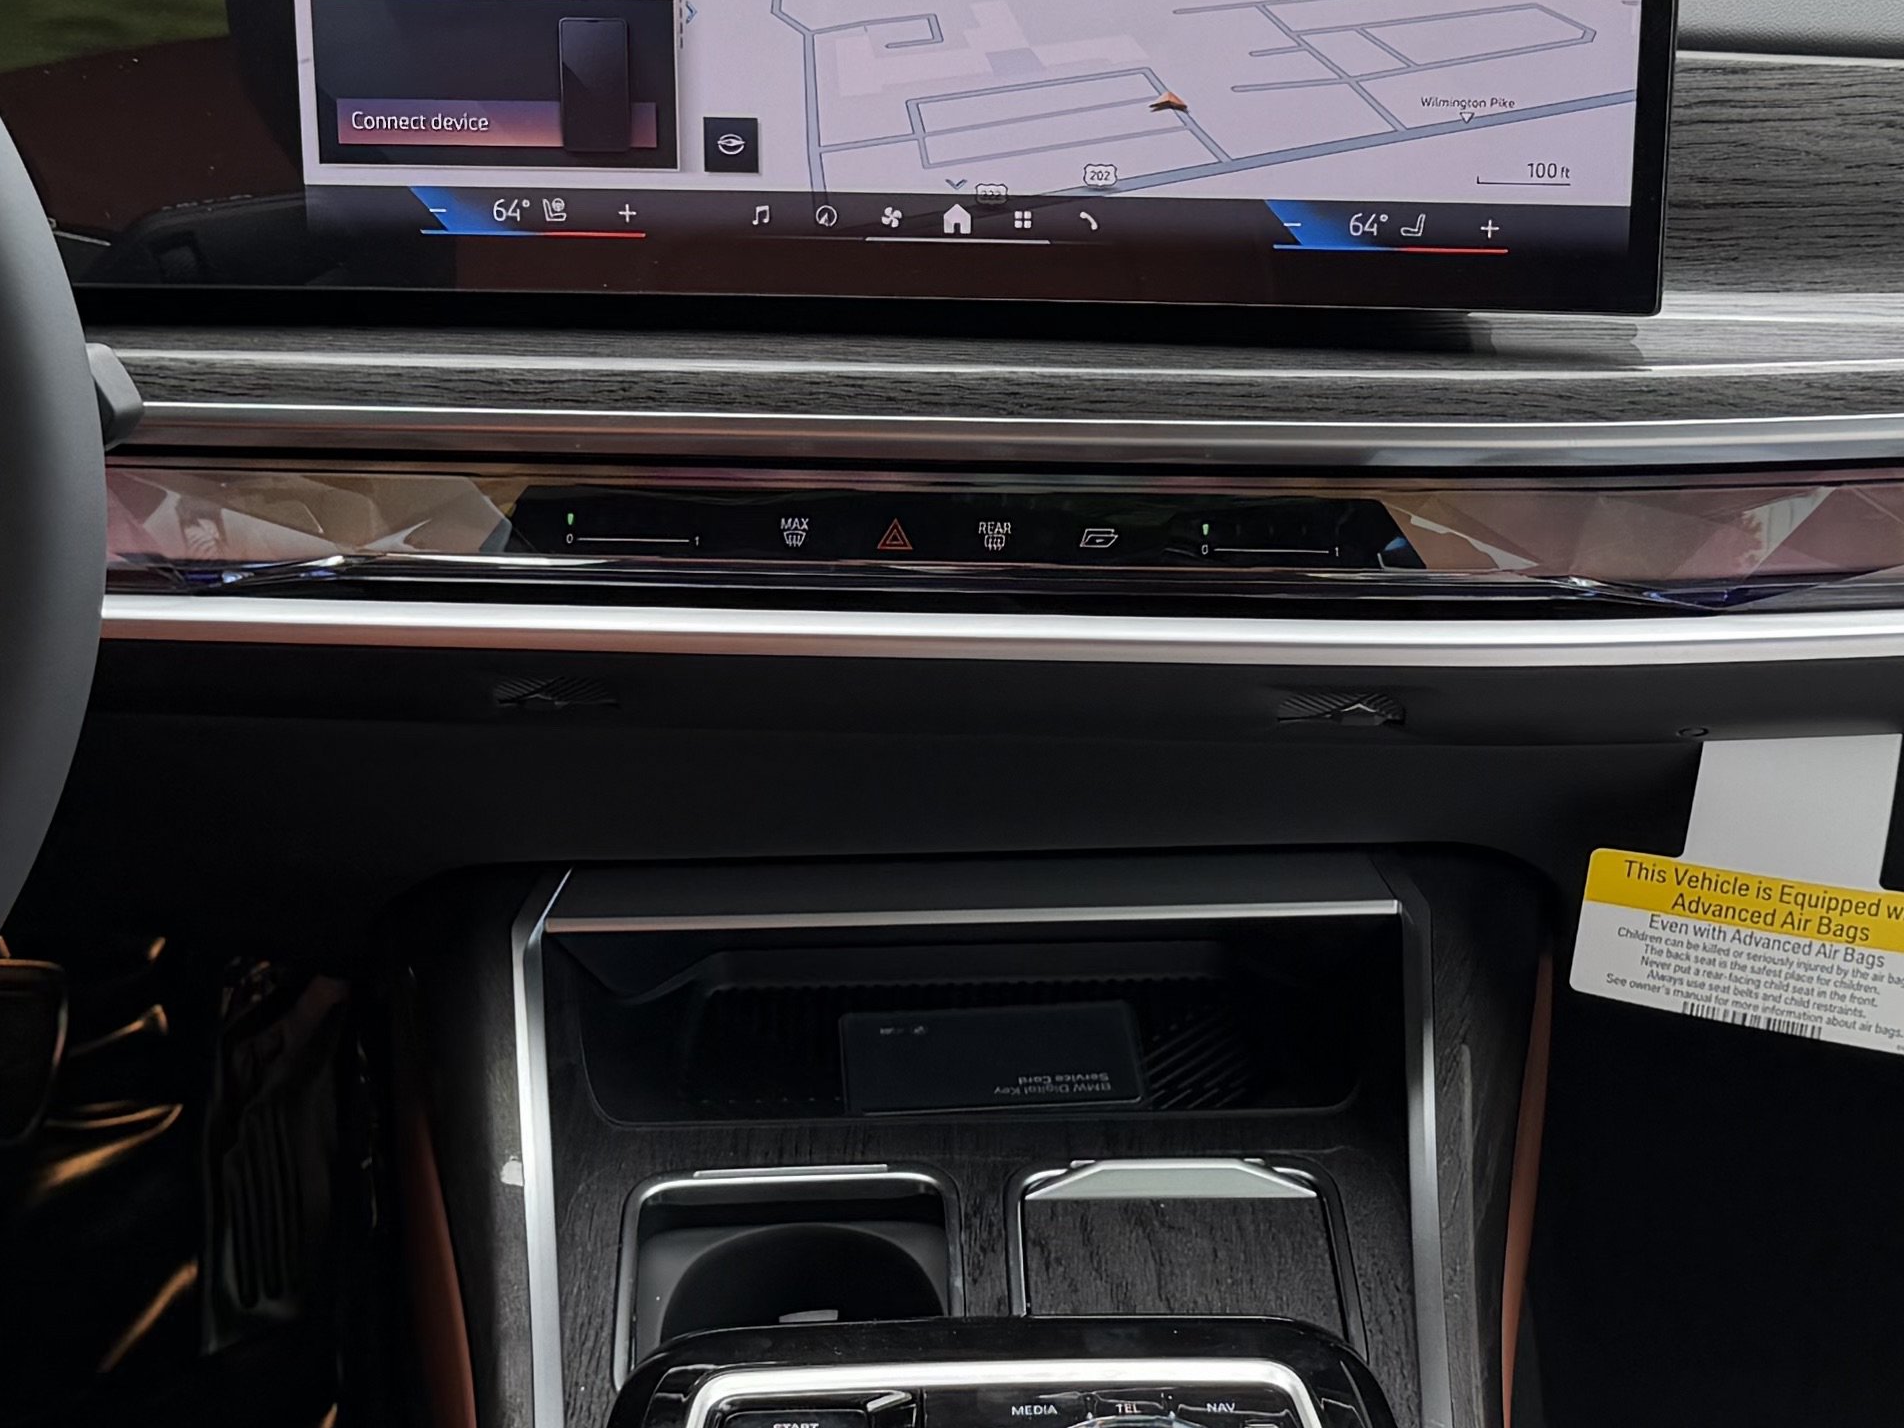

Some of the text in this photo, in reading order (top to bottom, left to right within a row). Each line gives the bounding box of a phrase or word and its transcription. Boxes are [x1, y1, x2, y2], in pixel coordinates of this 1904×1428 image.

[1420, 96, 1516, 111] Wilmington Pike
[351, 109, 490, 133] Connect device
[1089, 170, 1111, 182] 202
[1527, 162, 1571, 180] 100 ft
[492, 198, 531, 222] 64°
[1348, 212, 1389, 238] 64°
[779, 516, 810, 532] MAX
[977, 520, 1013, 536] REAR
[1623, 859, 1668, 884] This
[1674, 866, 1750, 897] Vehicle
[1755, 880, 1772, 901] is
[1779, 884, 1881, 918] Equipped
[1670, 892, 1871, 944] Advanced Air Bags
[1616, 926, 1663, 946] Children
[1664, 936, 1684, 949] can
[1685, 937, 1701, 951] be
[1701, 941, 1731, 957] killed
[1732, 949, 1745, 960] or
[1746, 949, 1795, 970] seriously
[1796, 958, 1835, 976] injured
[1835, 963, 1850, 979] by
[1851, 967, 1870, 981] the
[1871, 971, 1886, 983] air
[1648, 915, 1886, 970] Even with Advanced Air Bags
[1640, 955, 1879, 1008] Never put a rear-facing child seat in the front.
[1643, 944, 1881, 995] The back seat is the safest place for children.
[1606, 972, 1904, 1040] See owner's manual for more information about air bags.
[1646, 969, 1866, 1019] Always use seat belts and child restraints.
[992, 1084, 1022, 1097] Key
[1017, 1071, 1111, 1086] Service Card
[1010, 1403, 1058, 1417] MEDIA
[1115, 1402, 1141, 1415] TEL
[1206, 1401, 1237, 1414] NAV
